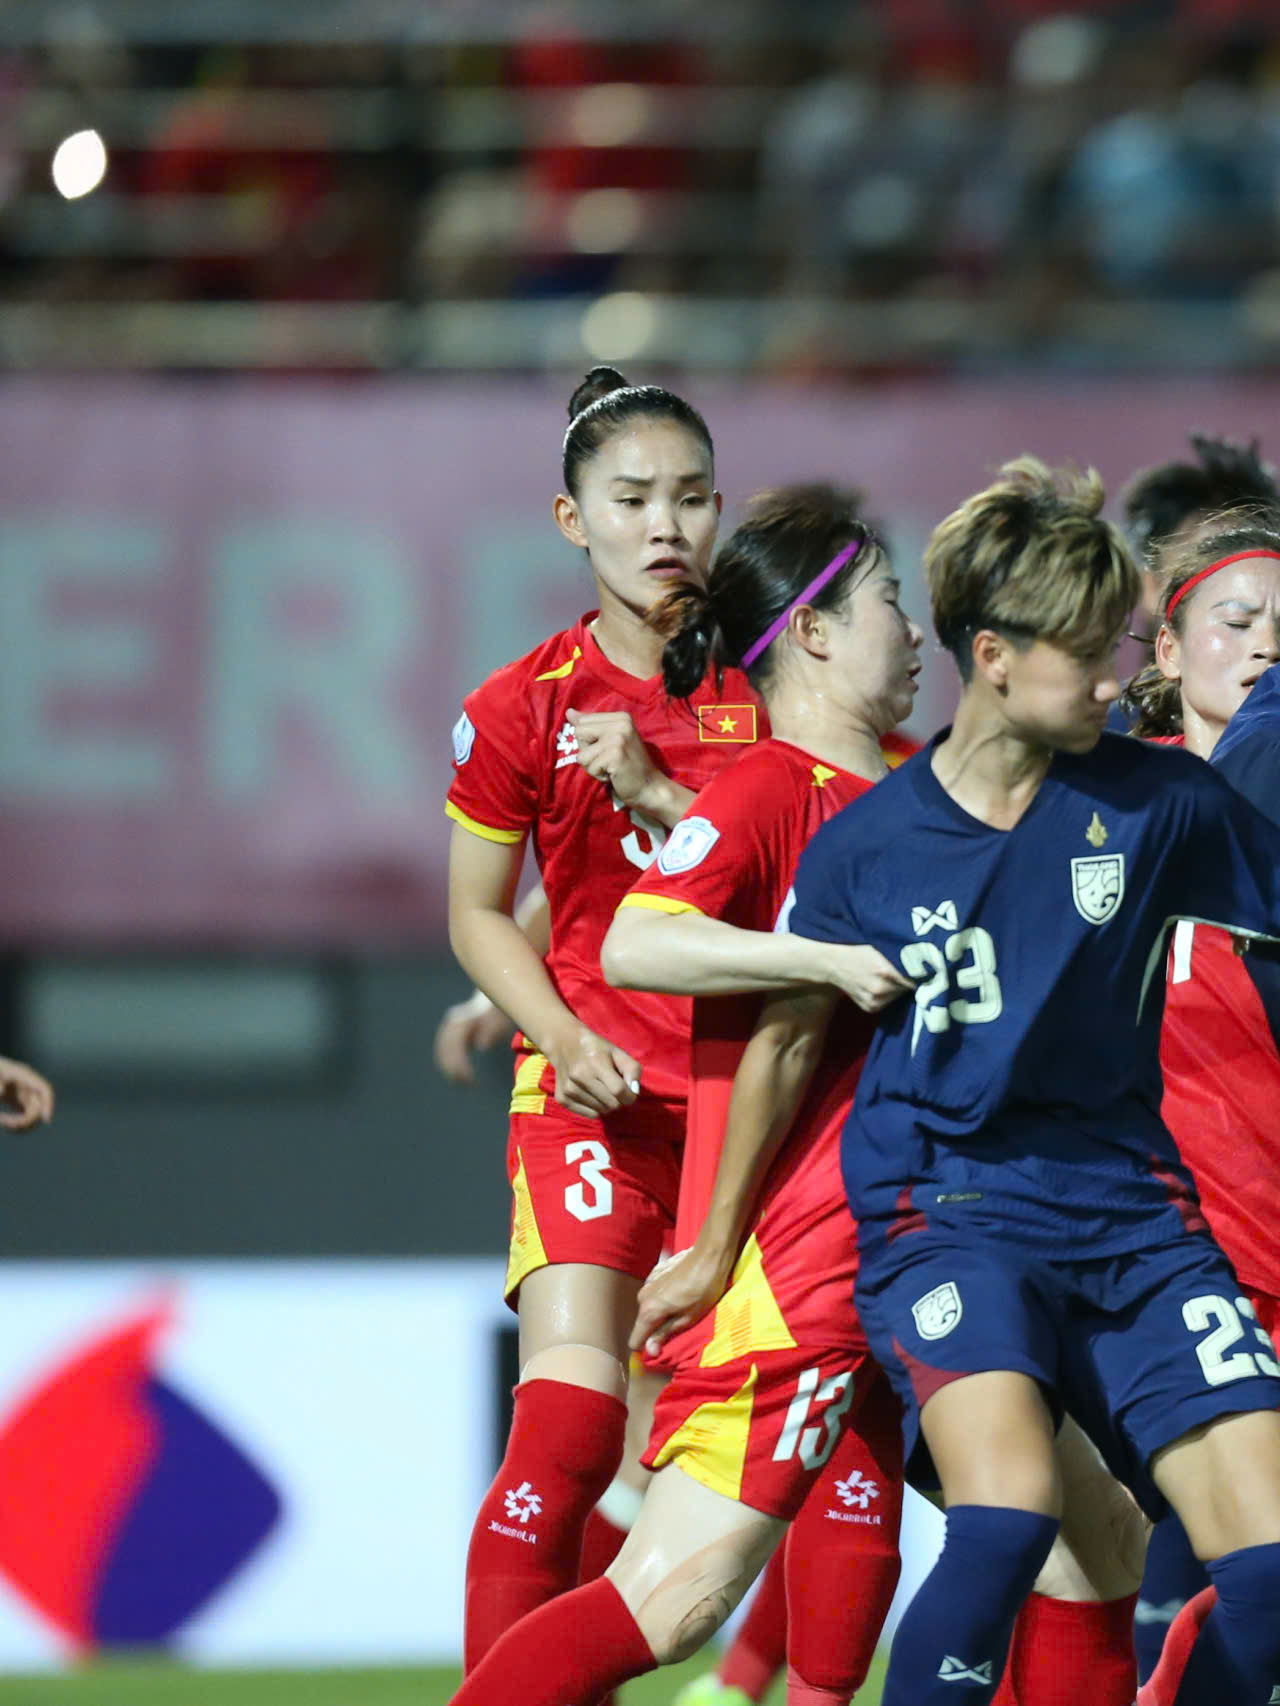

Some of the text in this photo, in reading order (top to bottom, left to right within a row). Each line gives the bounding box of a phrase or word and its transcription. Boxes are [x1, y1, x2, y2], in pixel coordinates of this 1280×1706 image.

[900, 926, 1002, 1034] 23
[564, 1140, 613, 1222] 3
[772, 1366, 855, 1470] 13
